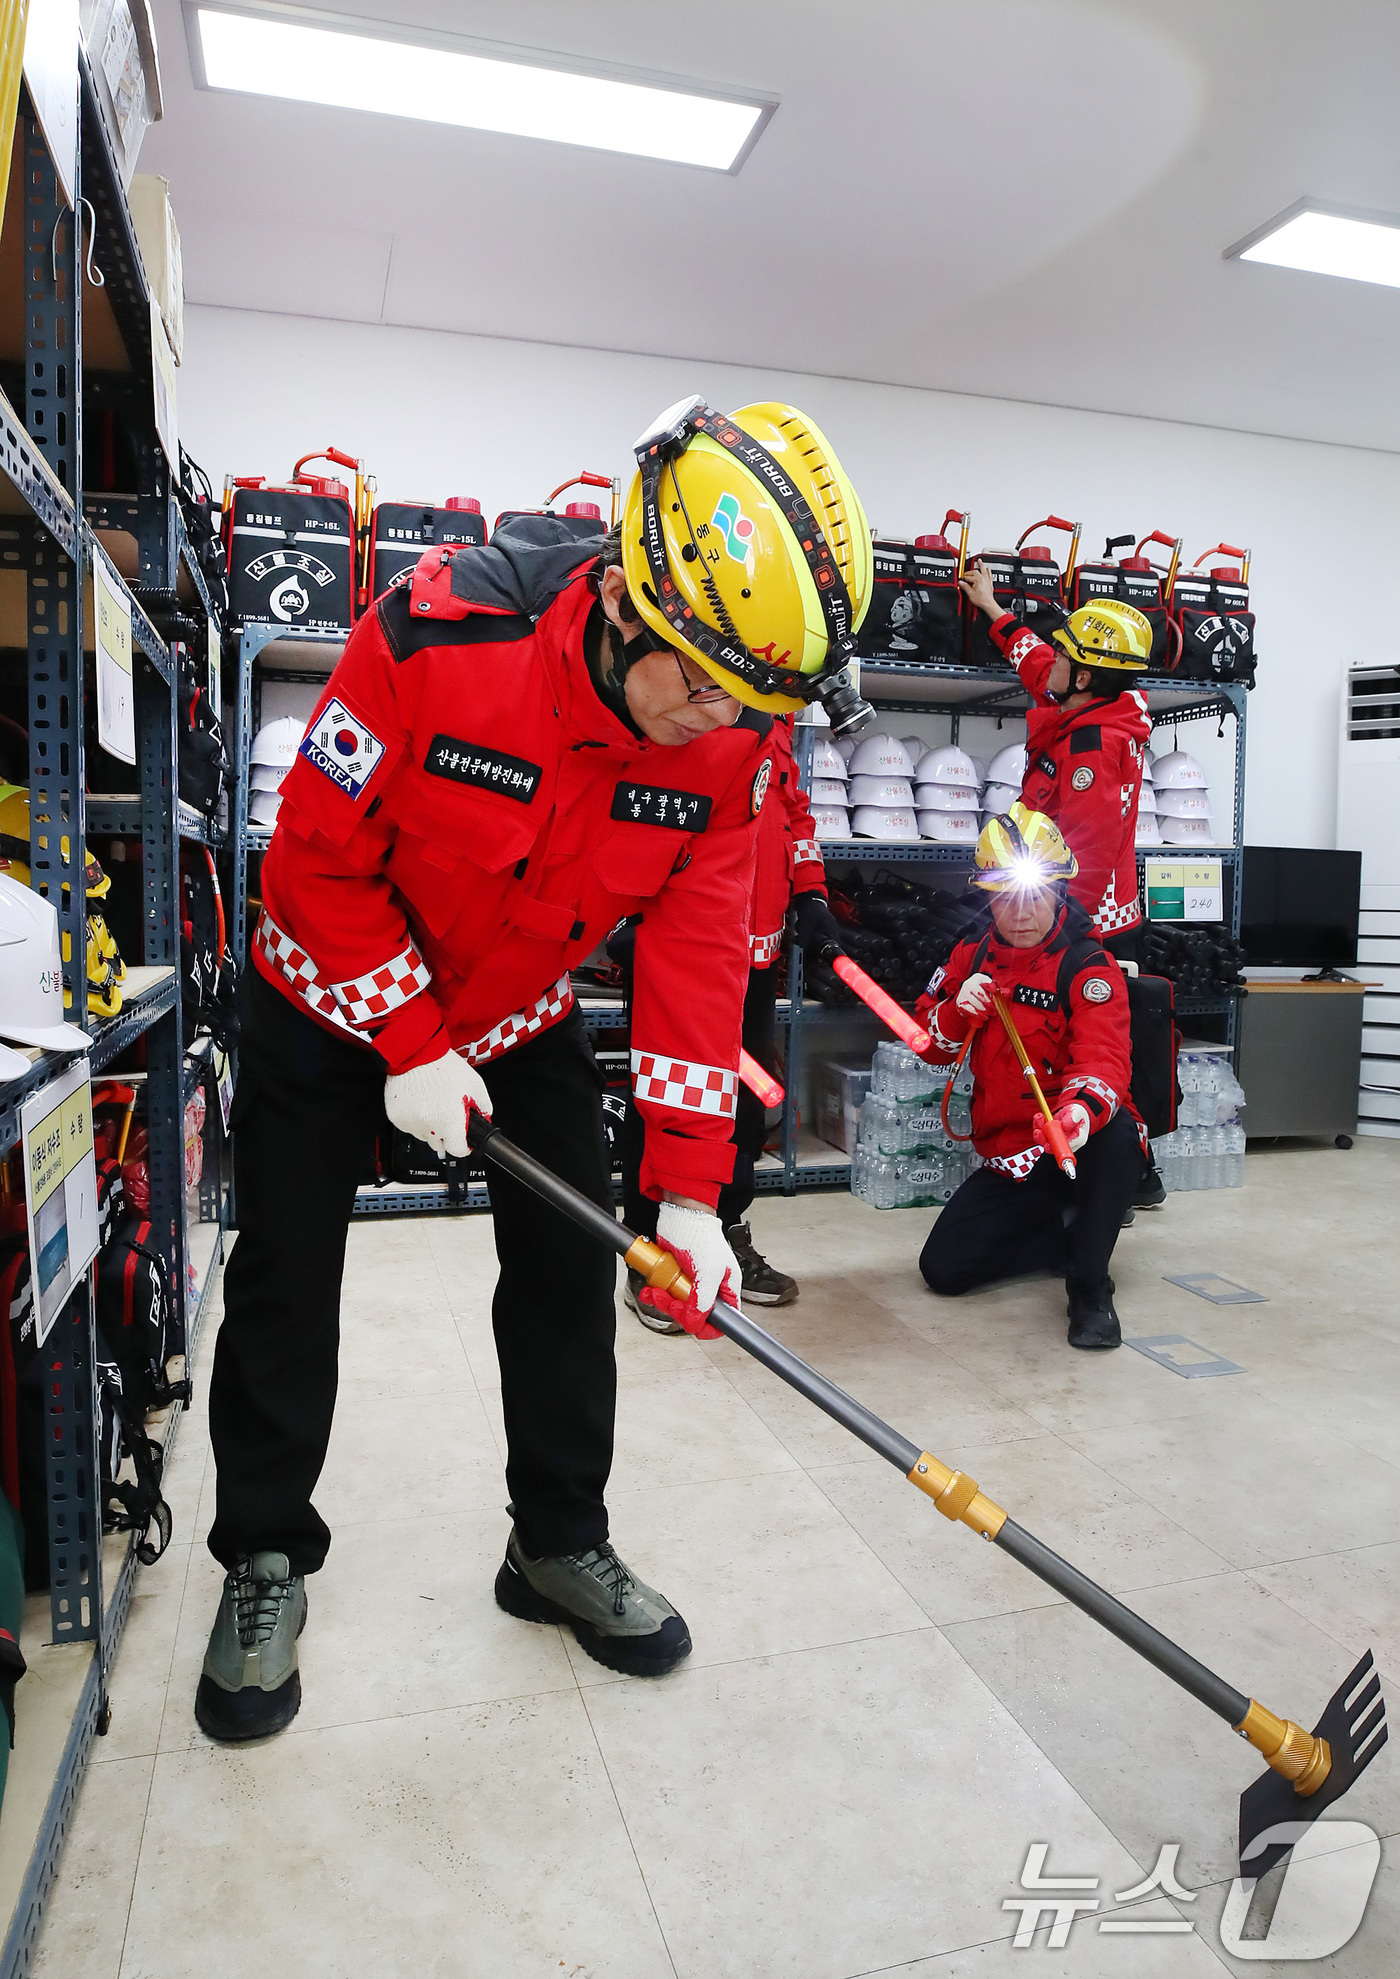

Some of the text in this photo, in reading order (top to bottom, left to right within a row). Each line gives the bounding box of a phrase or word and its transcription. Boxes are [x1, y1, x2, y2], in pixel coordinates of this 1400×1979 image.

[305, 519, 340, 530] HP-15L
[443, 534, 476, 544] HP-15L
[253, 552, 331, 583] 산불조심
[1086, 616, 1116, 639] 진화대
[307, 745, 352, 792] KOREA
[437, 749, 534, 792] 산불전문예방진화대
[1190, 898, 1213, 909] 240
[39, 970, 63, 994] 산불
[916, 1171, 940, 1182] 삼다수
